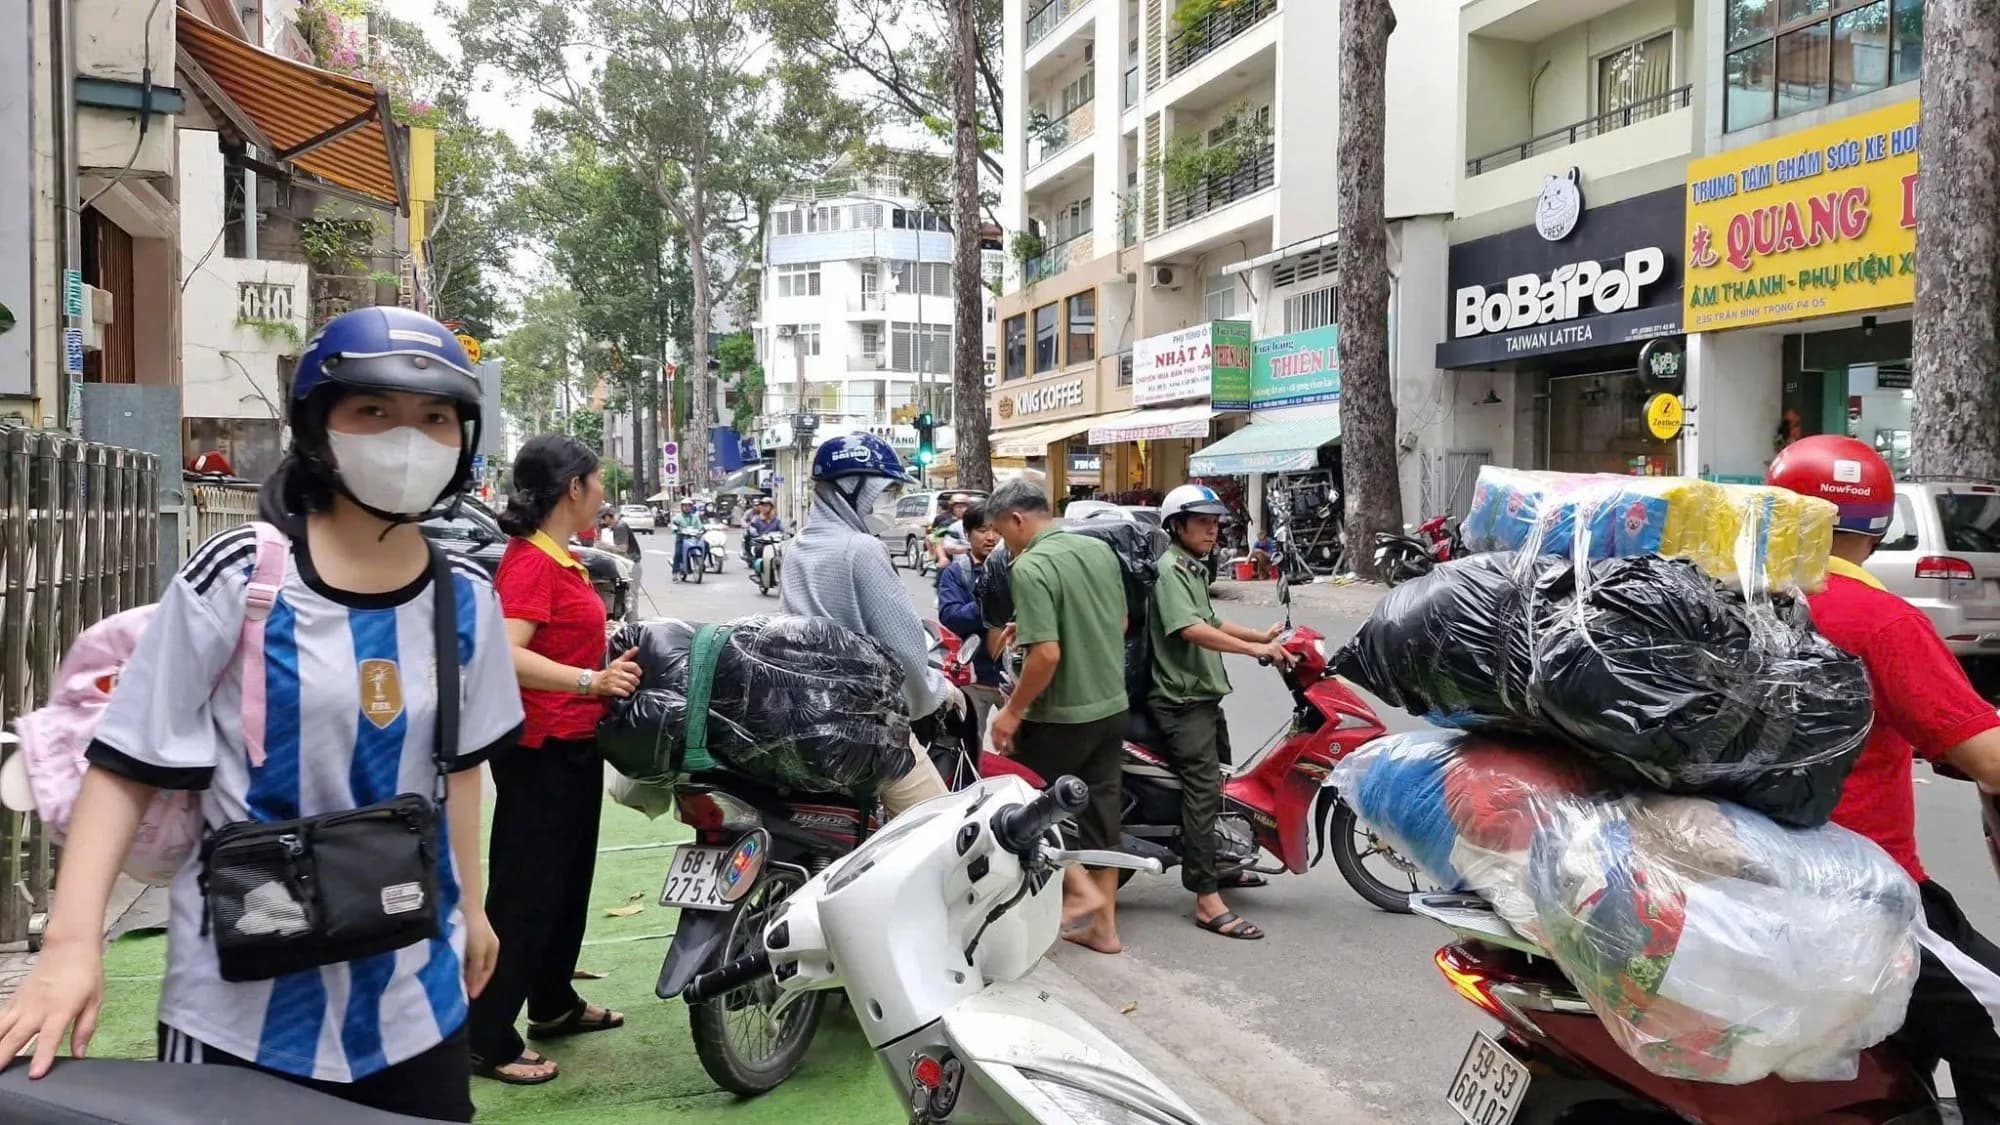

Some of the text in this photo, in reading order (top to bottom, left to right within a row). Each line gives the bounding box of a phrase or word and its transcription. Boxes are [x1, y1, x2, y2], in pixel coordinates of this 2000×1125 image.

[1692, 174, 1737, 204] TRUNG
[1827, 138, 1861, 171] SÓC
[1865, 133, 1887, 162] XE
[1543, 225, 1565, 238] FRESH
[1727, 186, 1870, 272] QUANG
[1722, 273, 1787, 301] THANH
[1799, 263, 1841, 291] PHỤ
[1843, 253, 1893, 284] KIỆN
[1898, 250, 1915, 276] X
[1155, 345, 1197, 368] NHẬT
[1506, 324, 1593, 352] TAIWAN LATTEA
[1271, 346, 1323, 378] THIÊN
[1016, 378, 1083, 416] KING COFFEE
[1820, 483, 1871, 496] NowFood
[1473, 1042, 1518, 1100] 59-S3
[1454, 1073, 1508, 1125] 681.07
